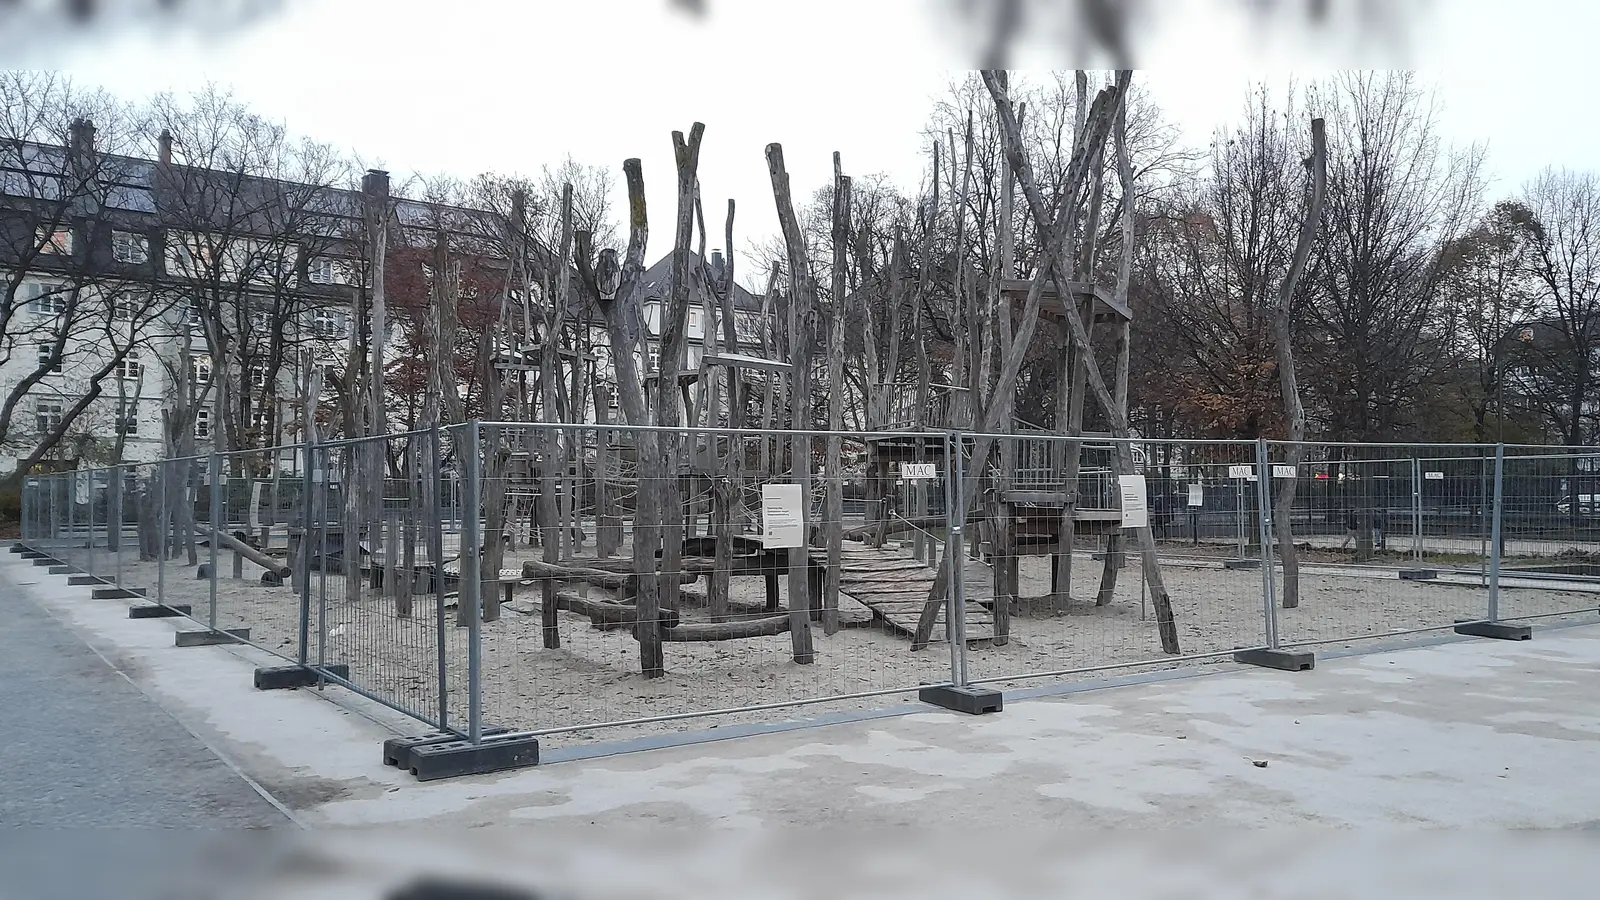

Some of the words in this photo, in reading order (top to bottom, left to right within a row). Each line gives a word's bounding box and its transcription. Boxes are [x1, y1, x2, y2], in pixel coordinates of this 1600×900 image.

[906, 465, 931, 476] MAC
[1232, 467, 1249, 476] MAC
[1276, 467, 1295, 476] MAC
